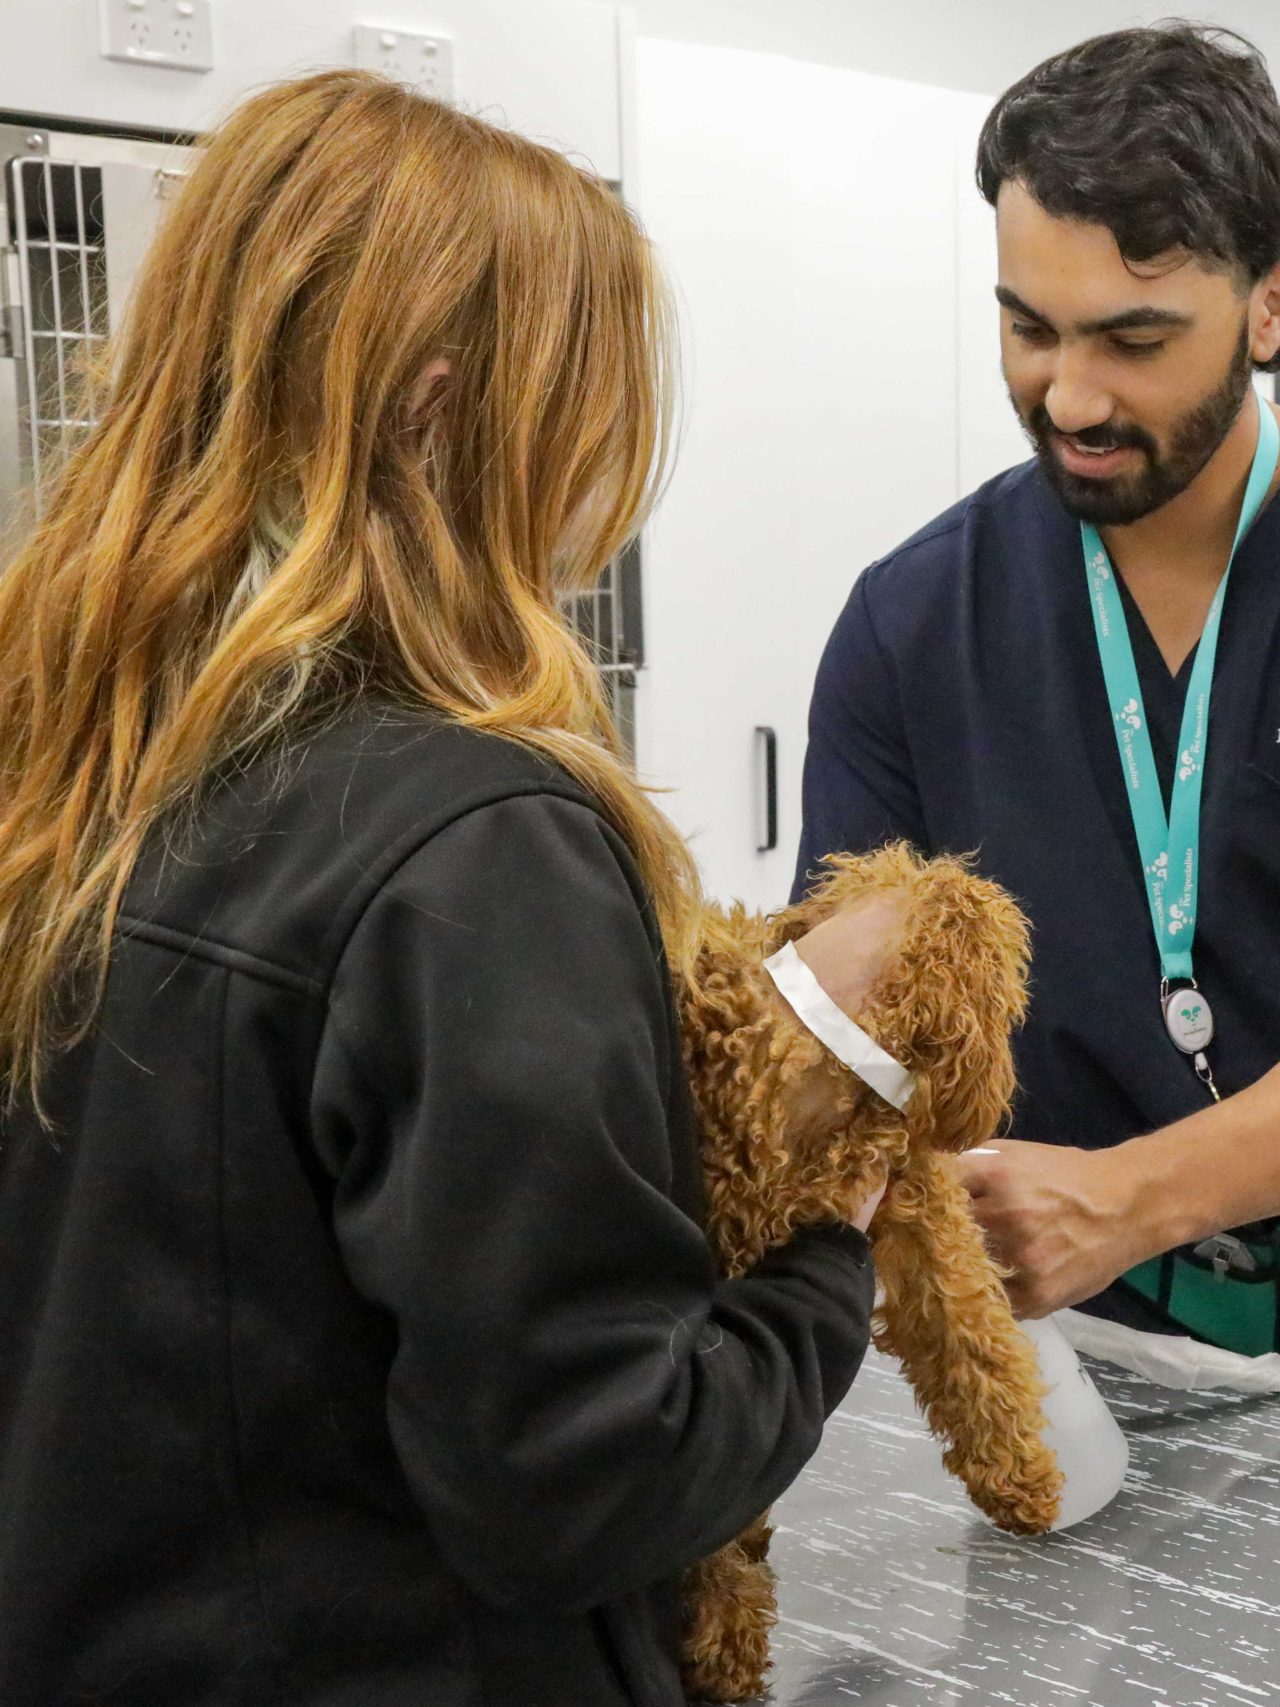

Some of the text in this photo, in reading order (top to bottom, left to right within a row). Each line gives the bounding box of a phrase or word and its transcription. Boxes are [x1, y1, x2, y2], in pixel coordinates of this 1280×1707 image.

[1121, 729, 1131, 743] Pet
[1183, 847, 1193, 907] Specialists Pet
